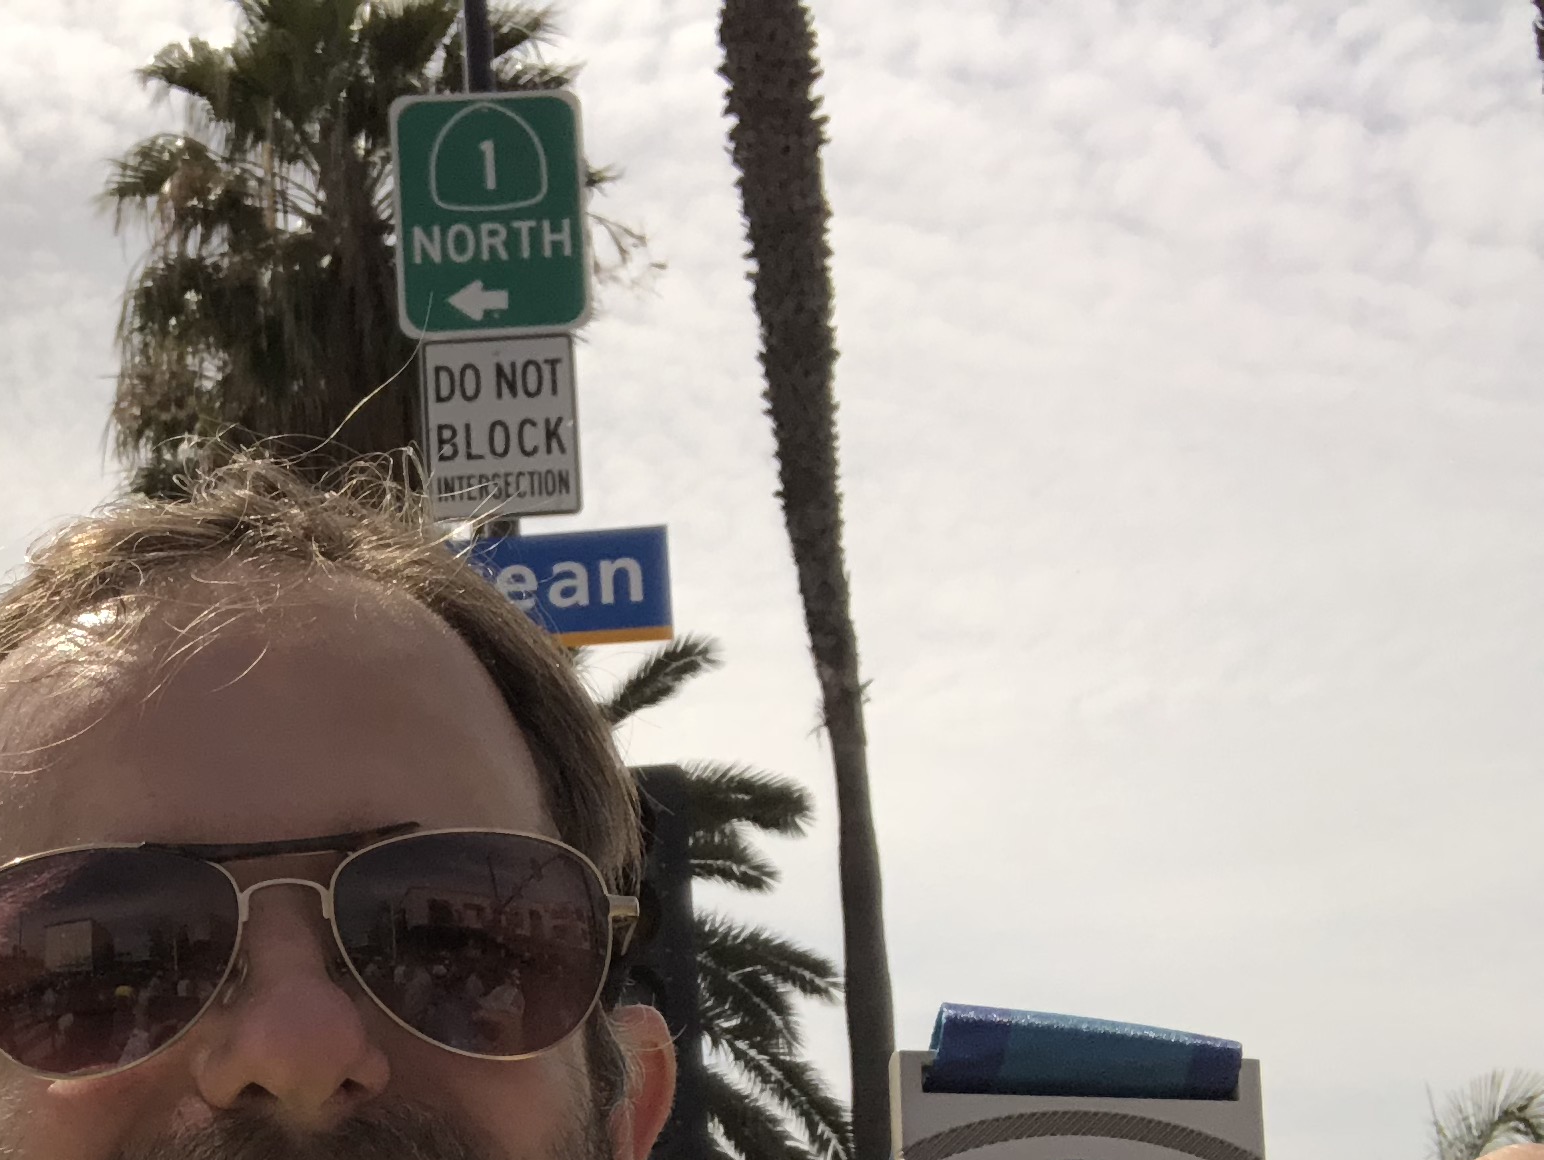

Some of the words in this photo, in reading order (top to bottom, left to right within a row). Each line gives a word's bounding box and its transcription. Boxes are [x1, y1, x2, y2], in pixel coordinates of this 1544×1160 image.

[478, 138, 497, 191] 1
[412, 218, 573, 264] NORTH
[433, 362, 481, 403] DO
[495, 357, 563, 400] NOT
[436, 416, 568, 462] BLOCK
[437, 469, 570, 503] INTERSECTION
[496, 557, 644, 612] ean
